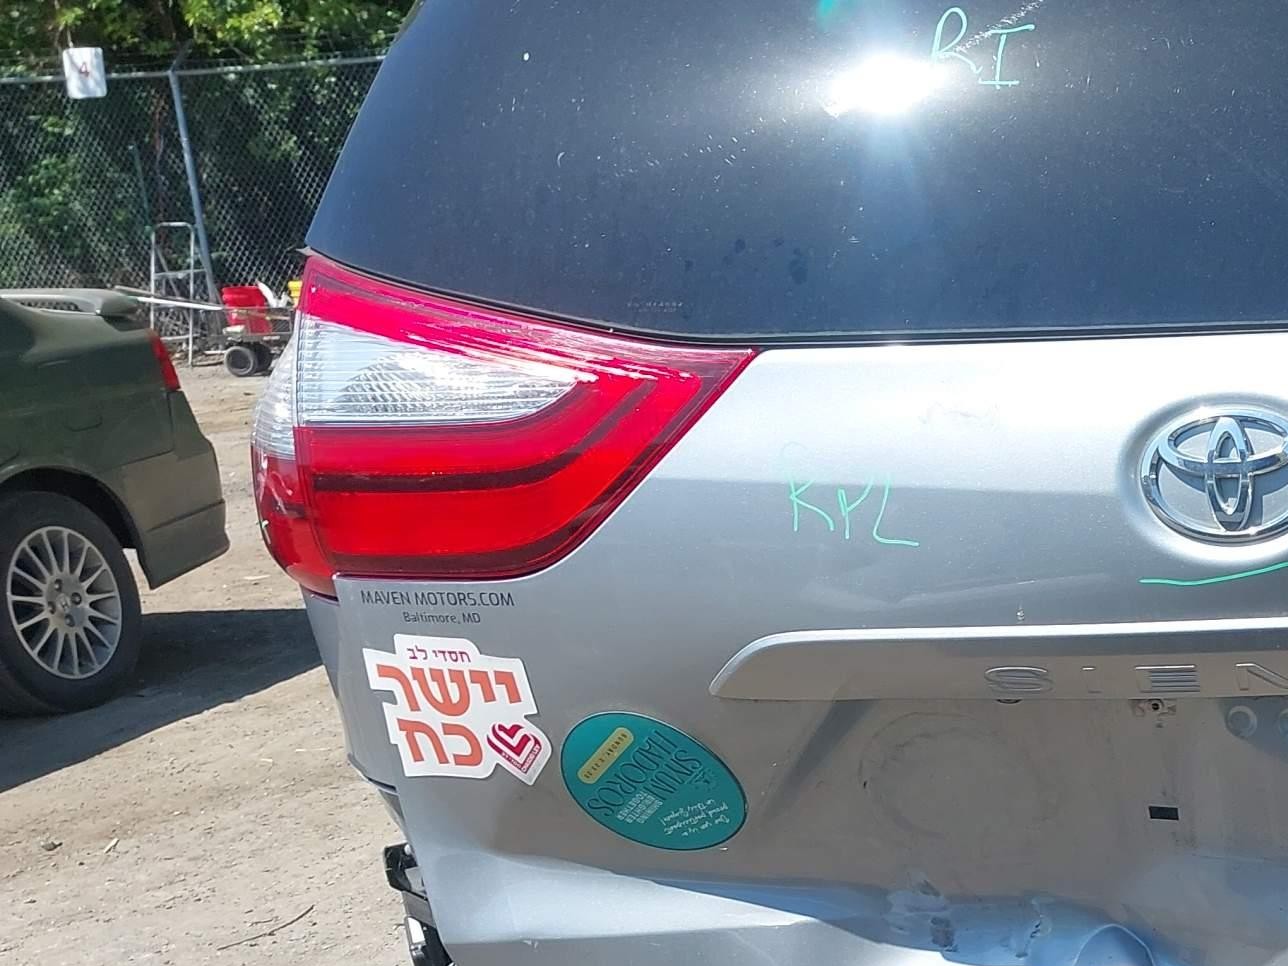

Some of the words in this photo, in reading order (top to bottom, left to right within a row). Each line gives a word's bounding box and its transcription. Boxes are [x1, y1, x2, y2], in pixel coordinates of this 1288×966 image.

[79, 61, 90, 77] 4
[360, 590, 411, 606] MAVEN
[414, 591, 515, 607] MOTORS.COM
[402, 611, 461, 625] Baltimore,
[462, 612, 481, 624] MD
[406, 645, 428, 660] לב
[396, 718, 484, 767] כח
[586, 729, 679, 817] HADOROS
